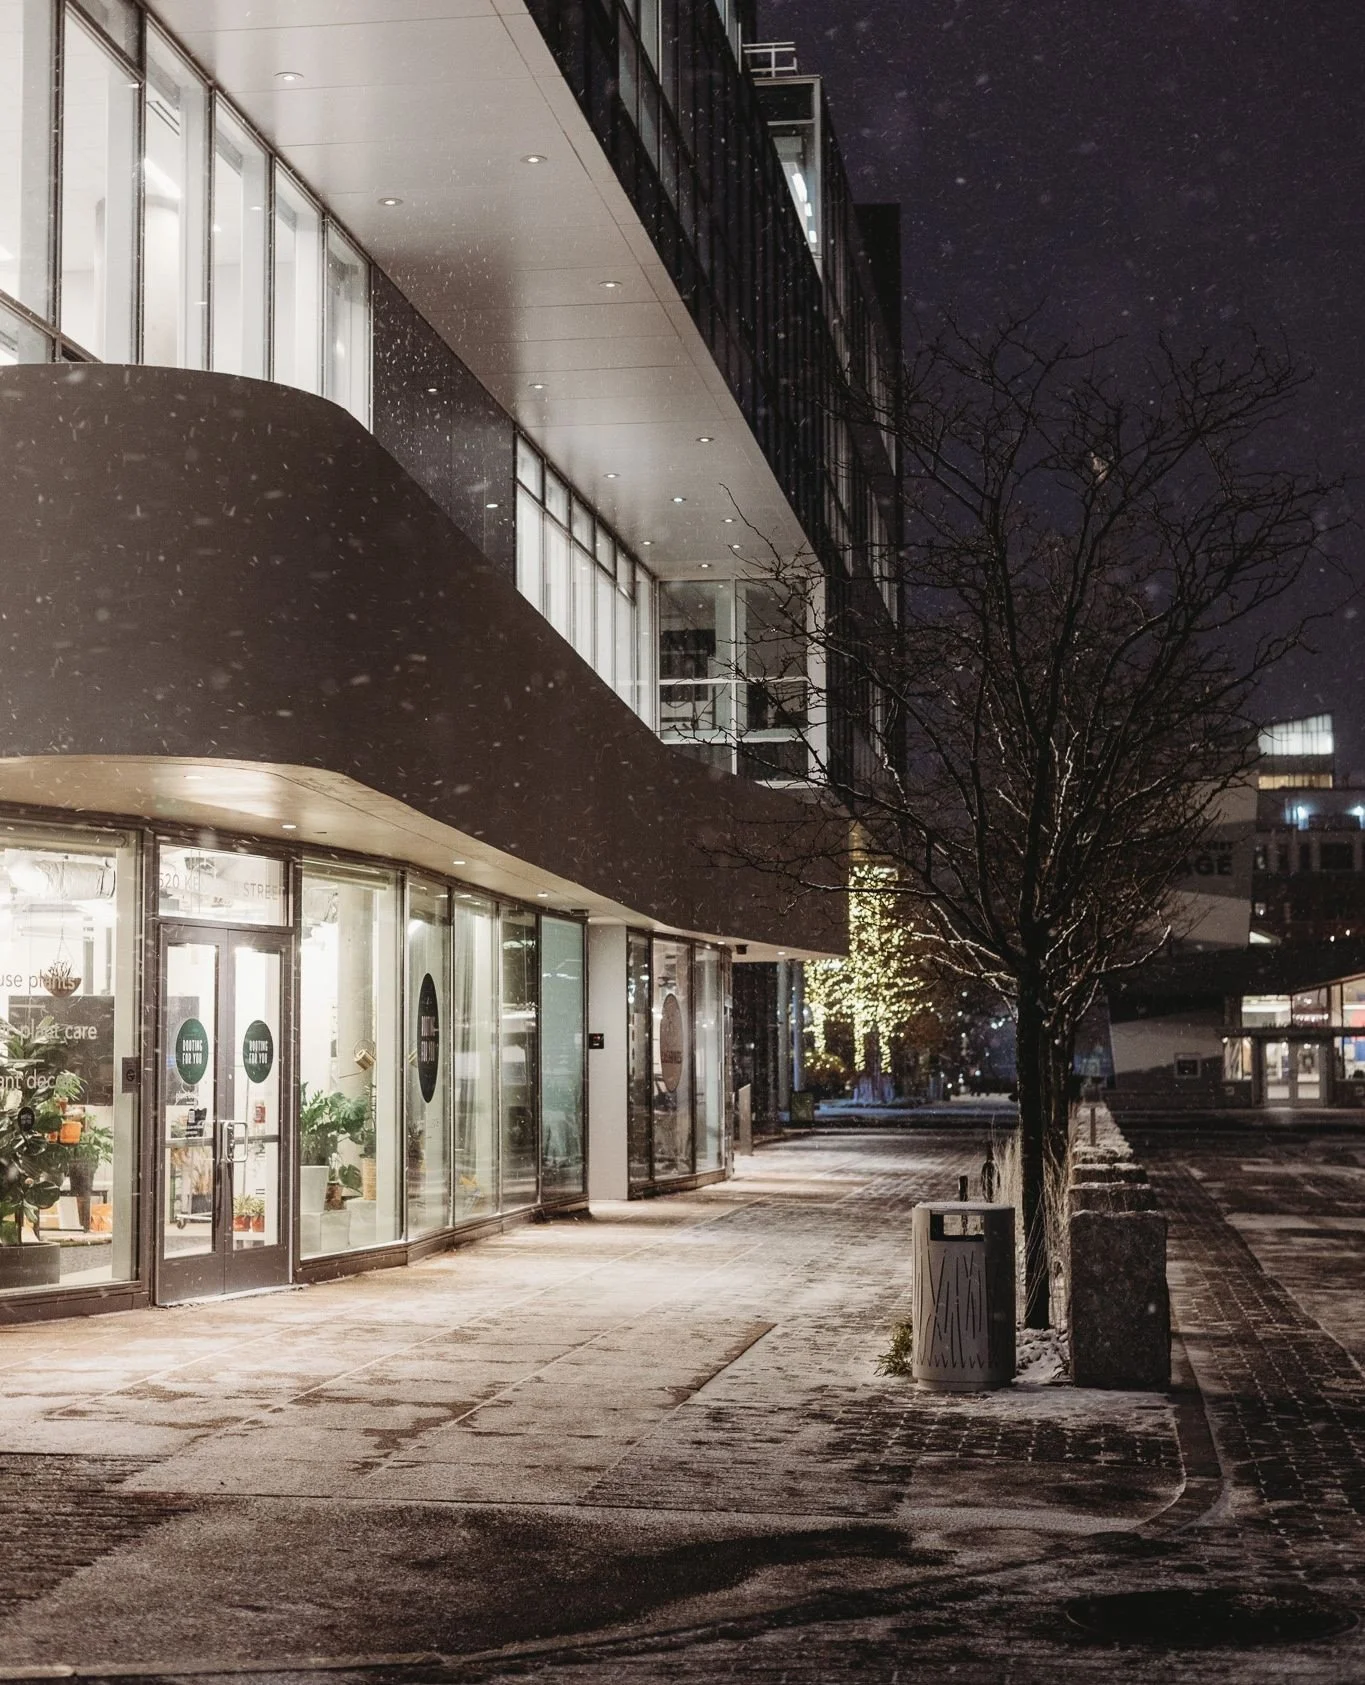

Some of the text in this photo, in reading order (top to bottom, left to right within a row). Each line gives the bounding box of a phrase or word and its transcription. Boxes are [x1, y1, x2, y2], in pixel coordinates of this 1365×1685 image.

[65, 1025, 98, 1040] care
[182, 1052, 203, 1065] FOR YOU
